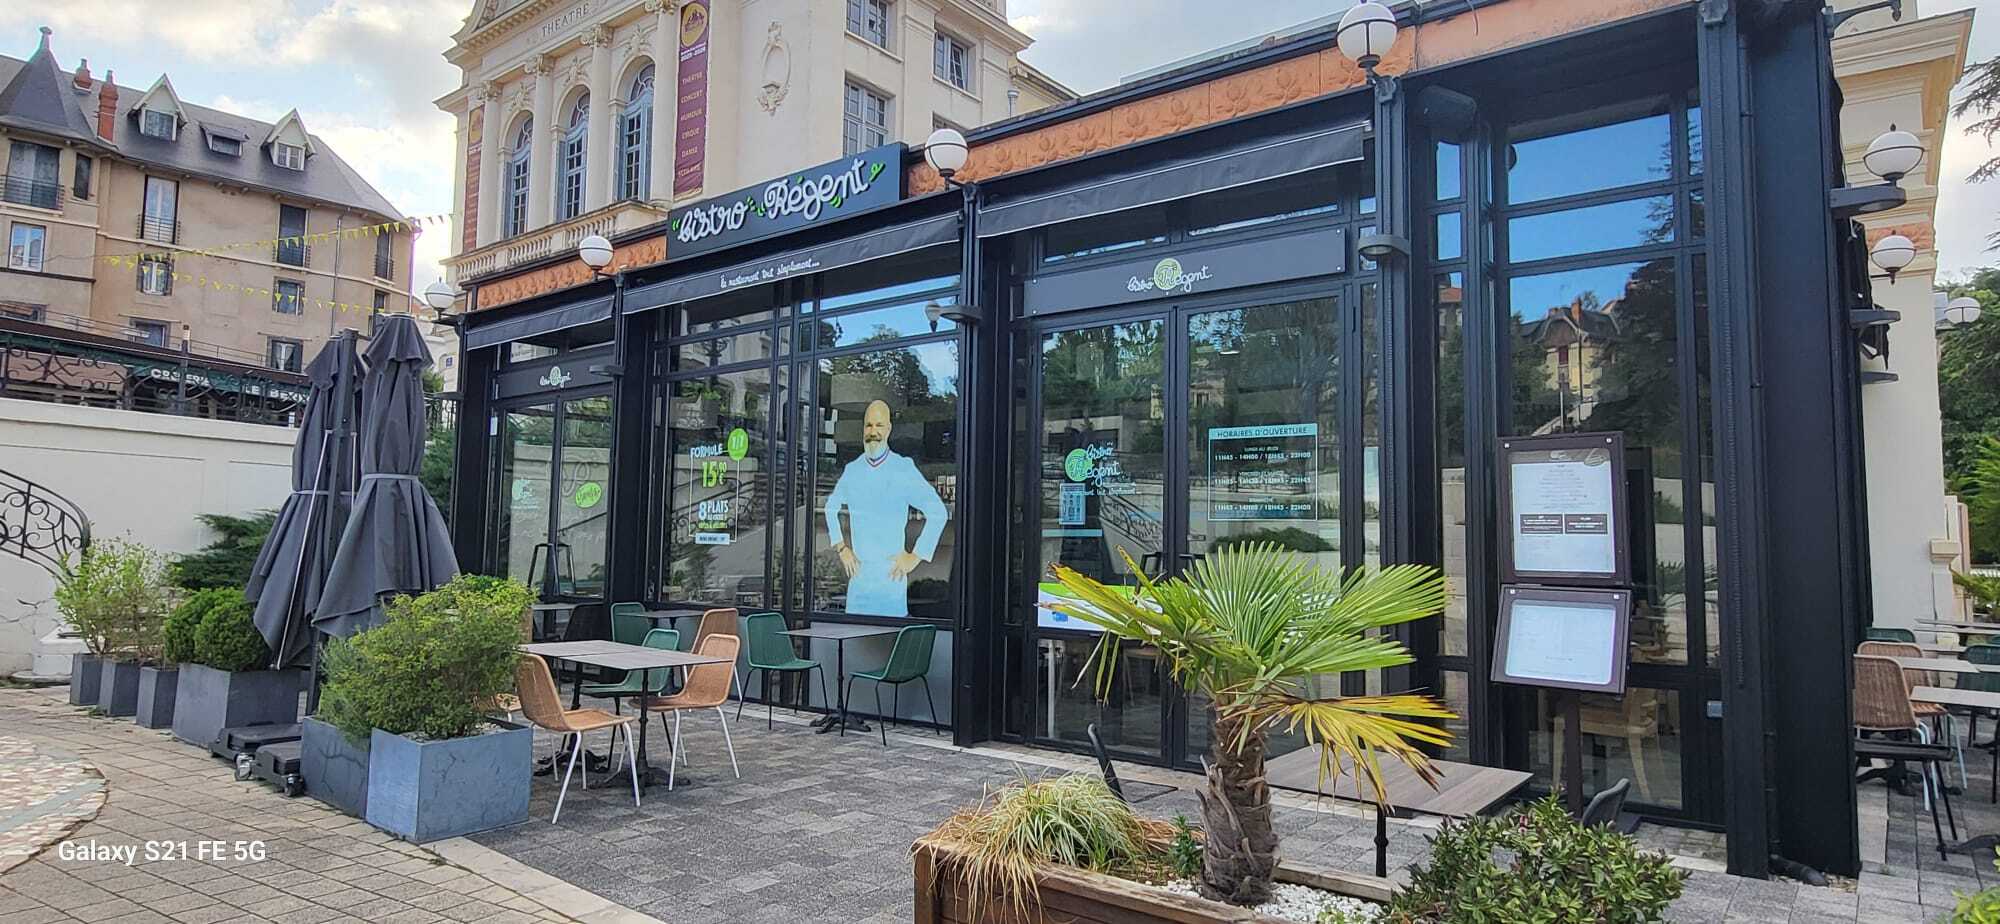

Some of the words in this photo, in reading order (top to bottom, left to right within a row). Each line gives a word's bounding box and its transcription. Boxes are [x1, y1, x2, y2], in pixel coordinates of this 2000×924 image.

[764, 157, 869, 220] Régent
[1217, 430, 1253, 438] HORAIRES
[1255, 426, 1307, 436] D'OUVERTURE
[690, 443, 724, 458] FORMULE
[698, 501, 707, 521] 8
[707, 499, 729, 513] PLATS
